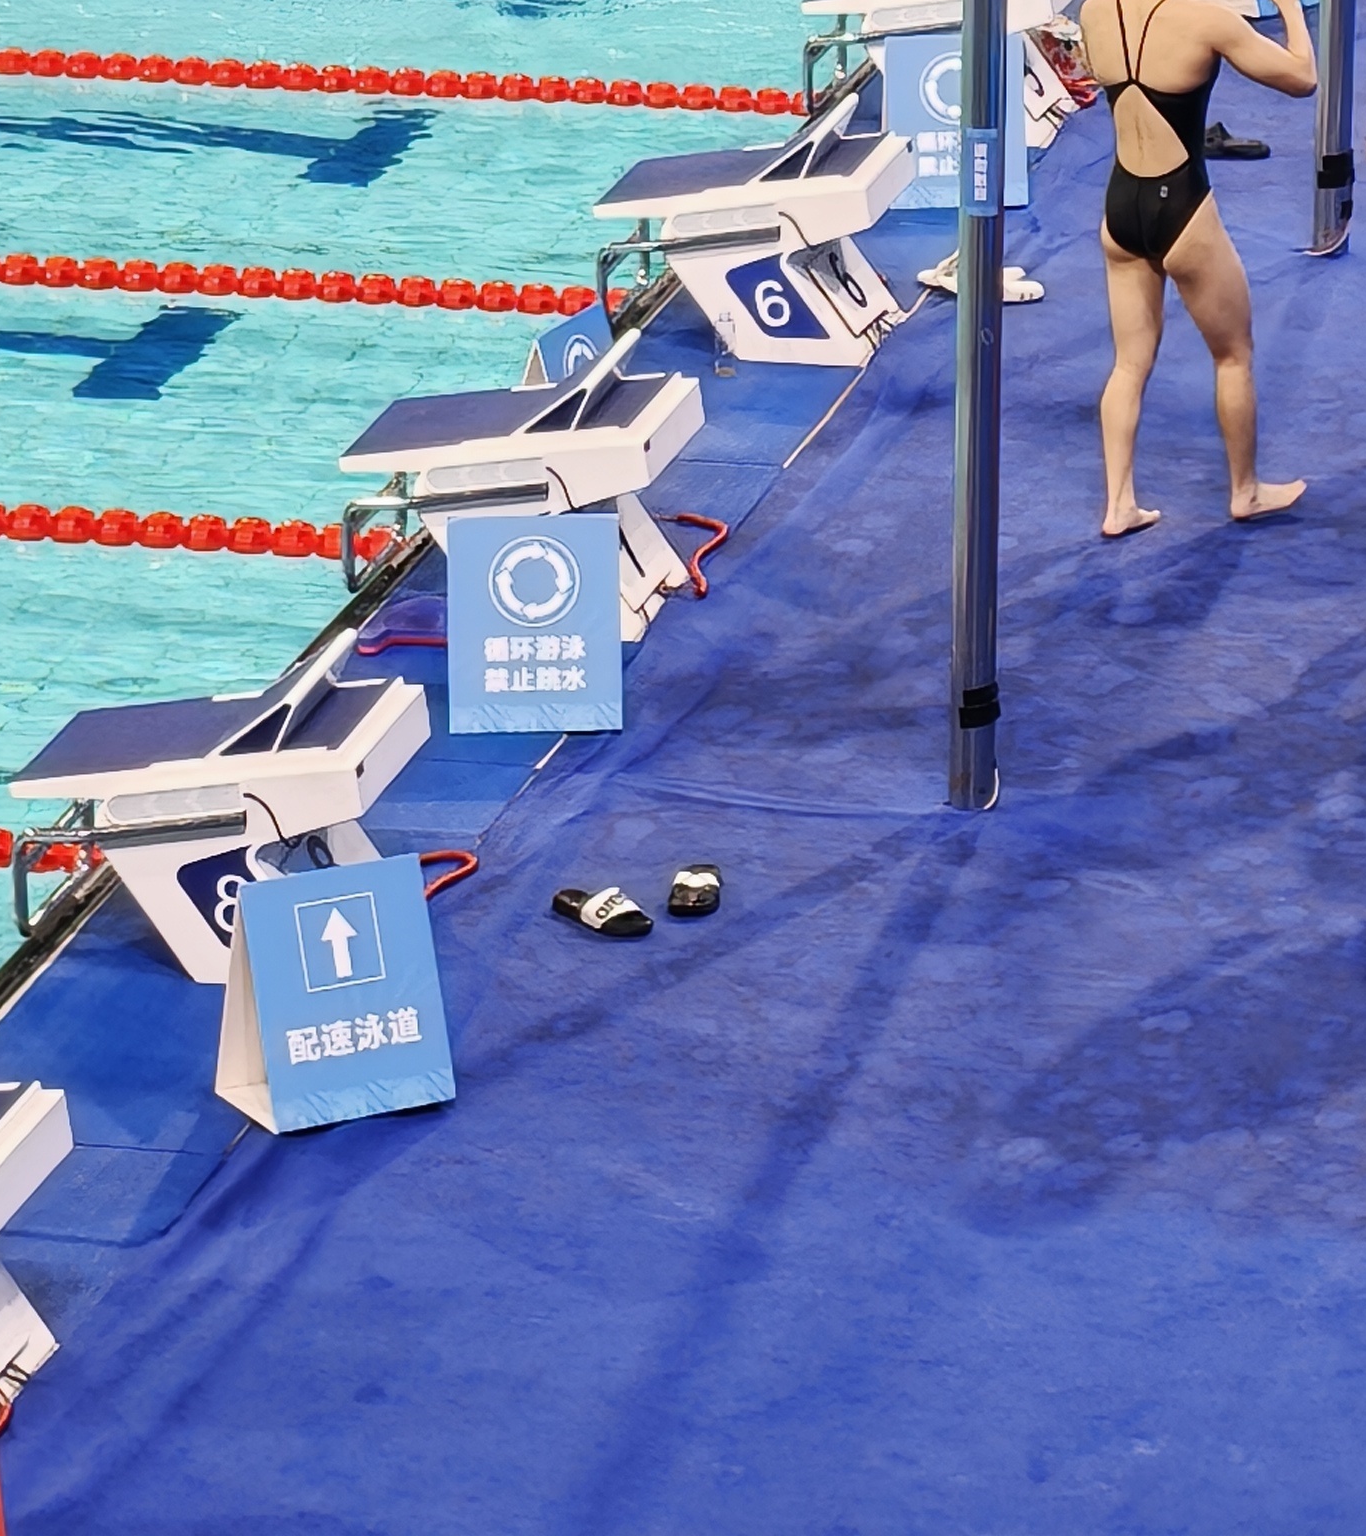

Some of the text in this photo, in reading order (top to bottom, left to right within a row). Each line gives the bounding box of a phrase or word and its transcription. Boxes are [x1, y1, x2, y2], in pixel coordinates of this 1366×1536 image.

[754, 280, 790, 327] 6
[286, 1006, 422, 1065] 配速泳道
